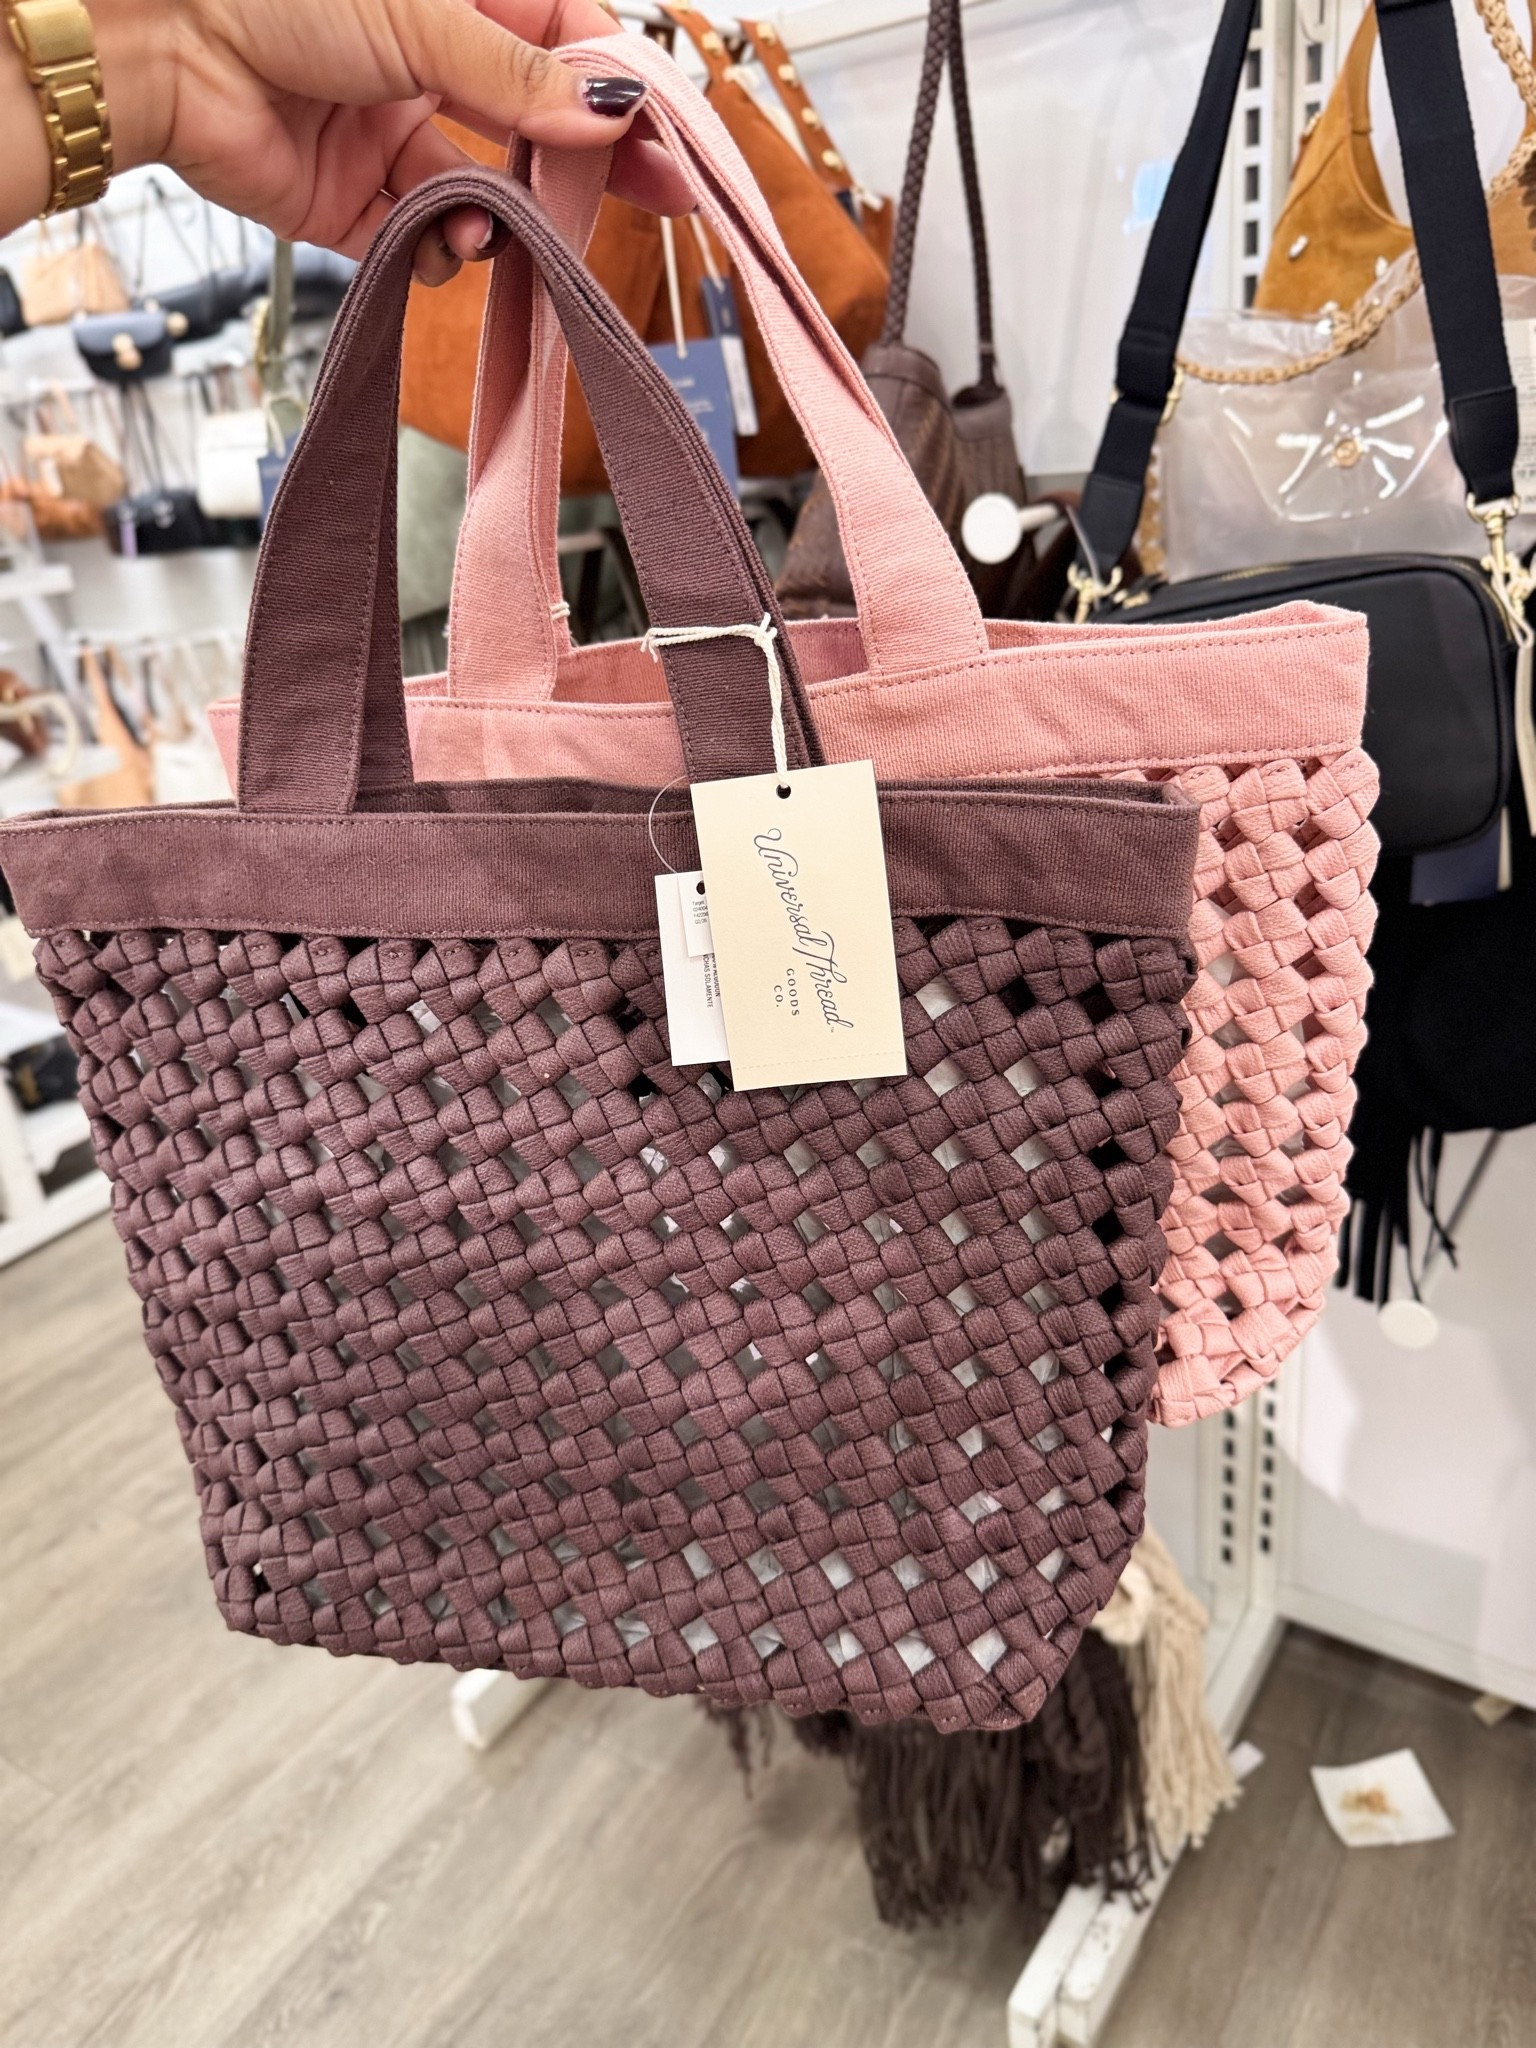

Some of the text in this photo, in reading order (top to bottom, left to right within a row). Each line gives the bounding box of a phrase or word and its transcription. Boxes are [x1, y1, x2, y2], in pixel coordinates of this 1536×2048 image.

[753, 827, 828, 947] Universal
[773, 984, 784, 1008] CO.
[786, 968, 800, 1016] GOODS
